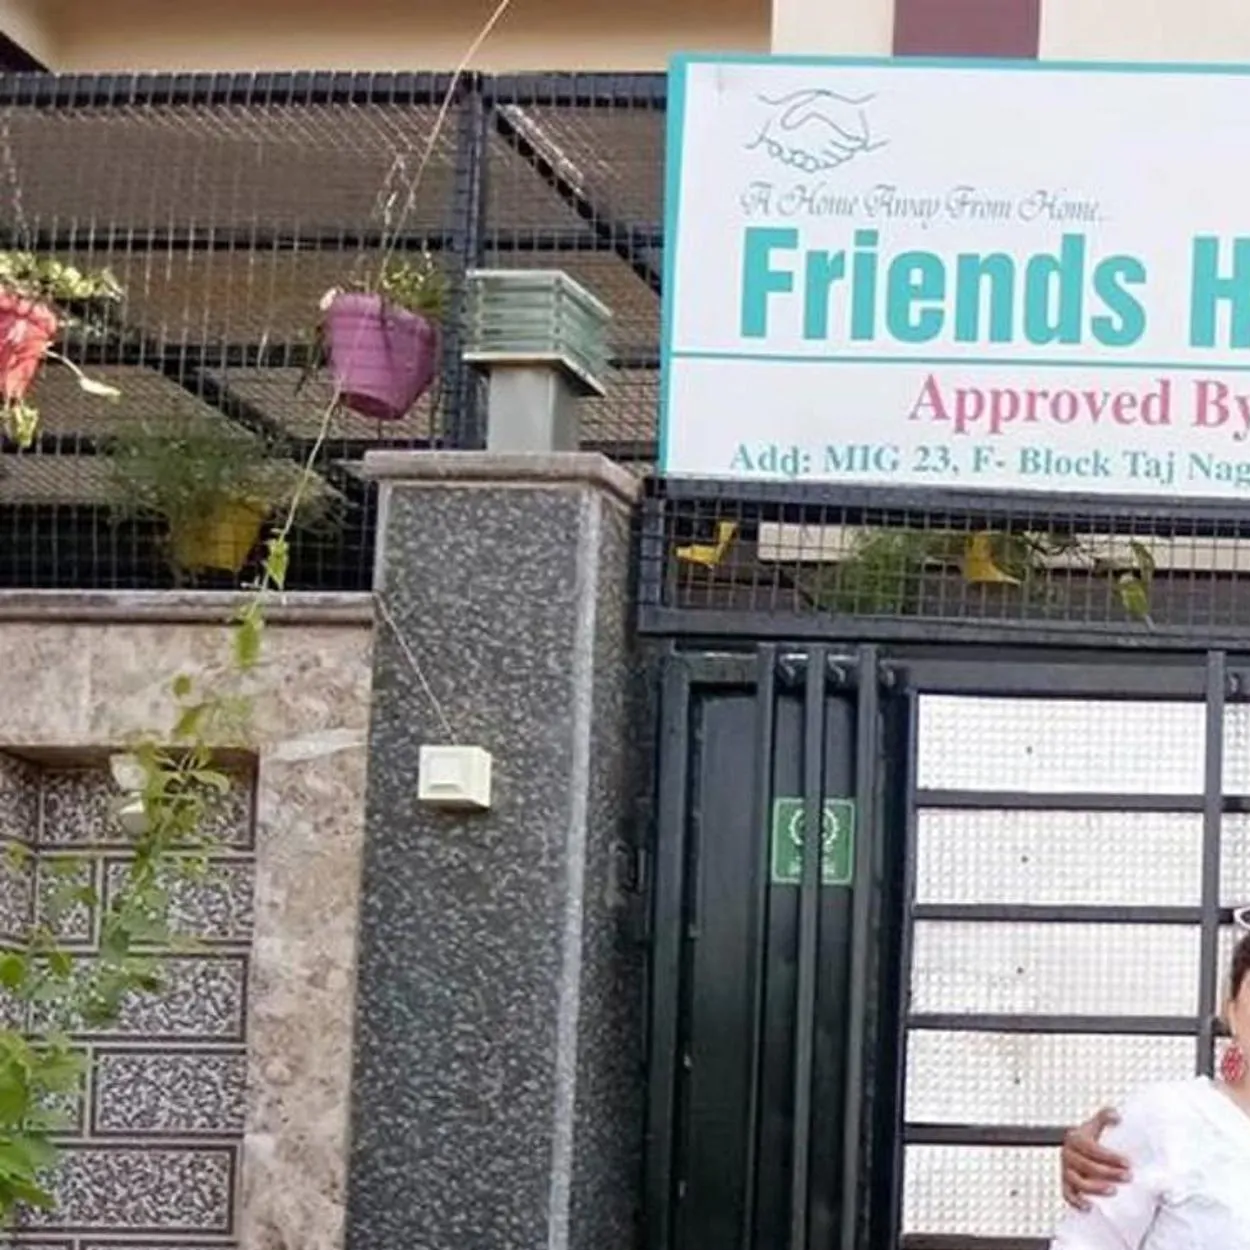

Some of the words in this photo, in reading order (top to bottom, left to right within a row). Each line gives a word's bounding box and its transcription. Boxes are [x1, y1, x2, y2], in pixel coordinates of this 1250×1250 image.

[739, 225, 1148, 348] Friends
[908, 373, 1172, 436] Approved
[729, 443, 812, 477] Add:
[823, 444, 900, 473] MIG
[1018, 447, 1111, 478] Block
[1122, 450, 1175, 486] Taj
